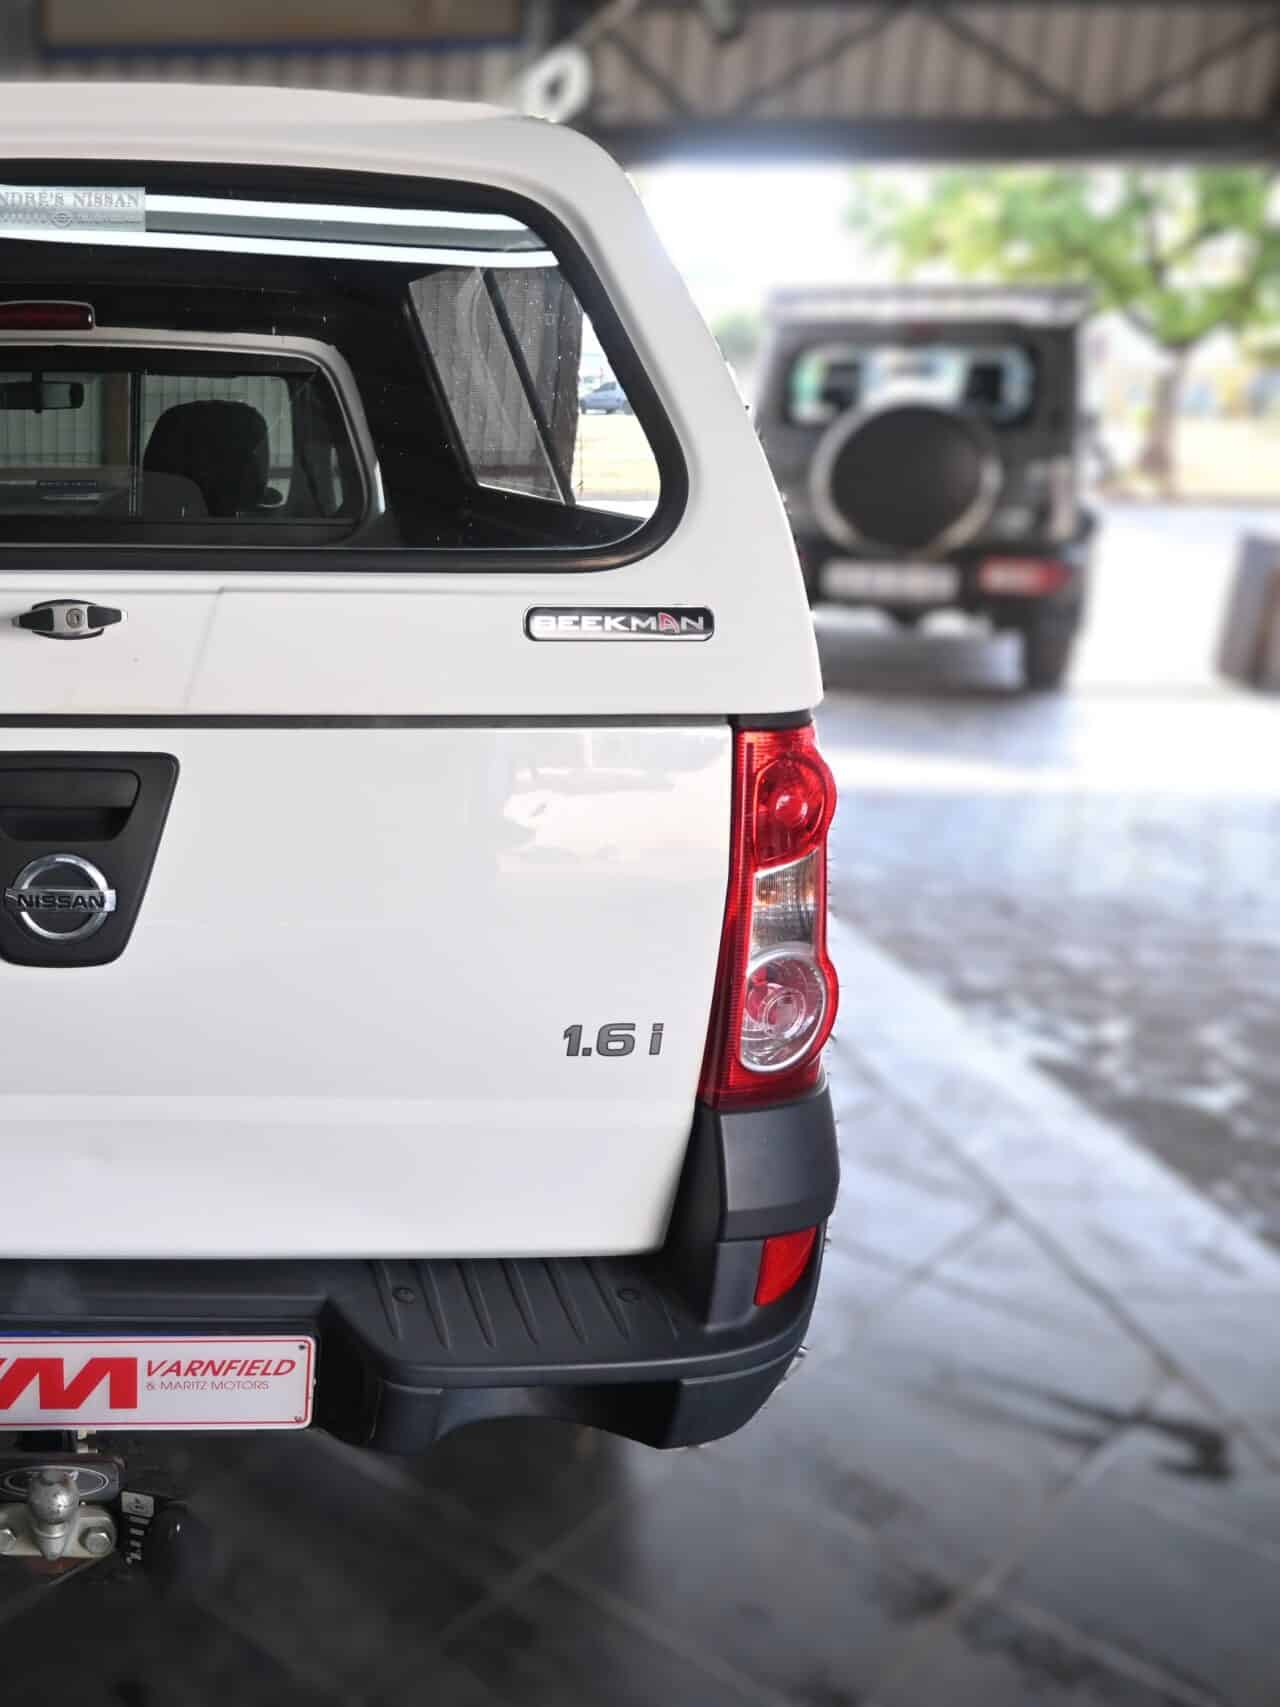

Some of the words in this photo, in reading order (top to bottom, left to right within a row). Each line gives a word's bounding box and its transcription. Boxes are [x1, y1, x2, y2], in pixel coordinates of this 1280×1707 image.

[72, 191, 140, 208] NISSAN
[532, 611, 705, 634] BEEKMAN
[18, 894, 106, 909] NISSAN
[146, 1359, 296, 1377] VARNFIELD
[145, 1381, 155, 1391] &
[160, 1380, 208, 1391] MARITZ
[211, 1380, 270, 1391] MOTORS
